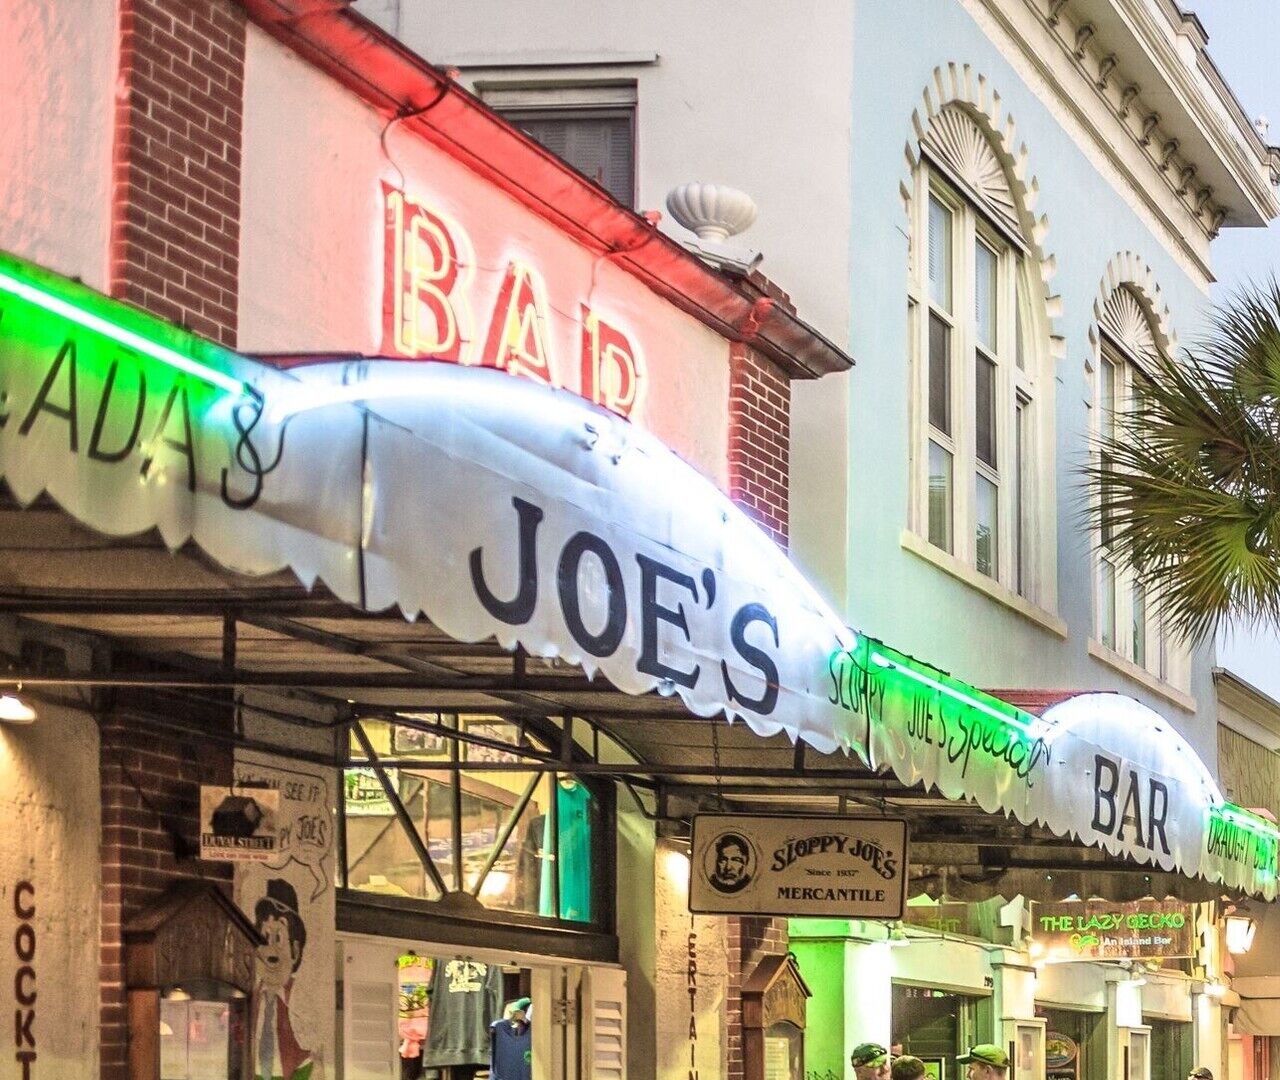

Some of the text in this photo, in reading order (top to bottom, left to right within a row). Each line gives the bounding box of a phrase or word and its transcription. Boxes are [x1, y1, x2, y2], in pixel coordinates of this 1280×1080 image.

[380, 180, 650, 423] BAR
[0, 338, 196, 492] ADA
[469, 497, 780, 714] JOE'S
[1091, 754, 1171, 855] BAR
[771, 836, 897, 879] SLOPPY JOE'S
[778, 887, 885, 901] MERCANTILE
[1040, 911, 1185, 931] THE LAZY GECKO
[1119, 936, 1151, 945] Island
[1154, 936, 1173, 945] Bar
